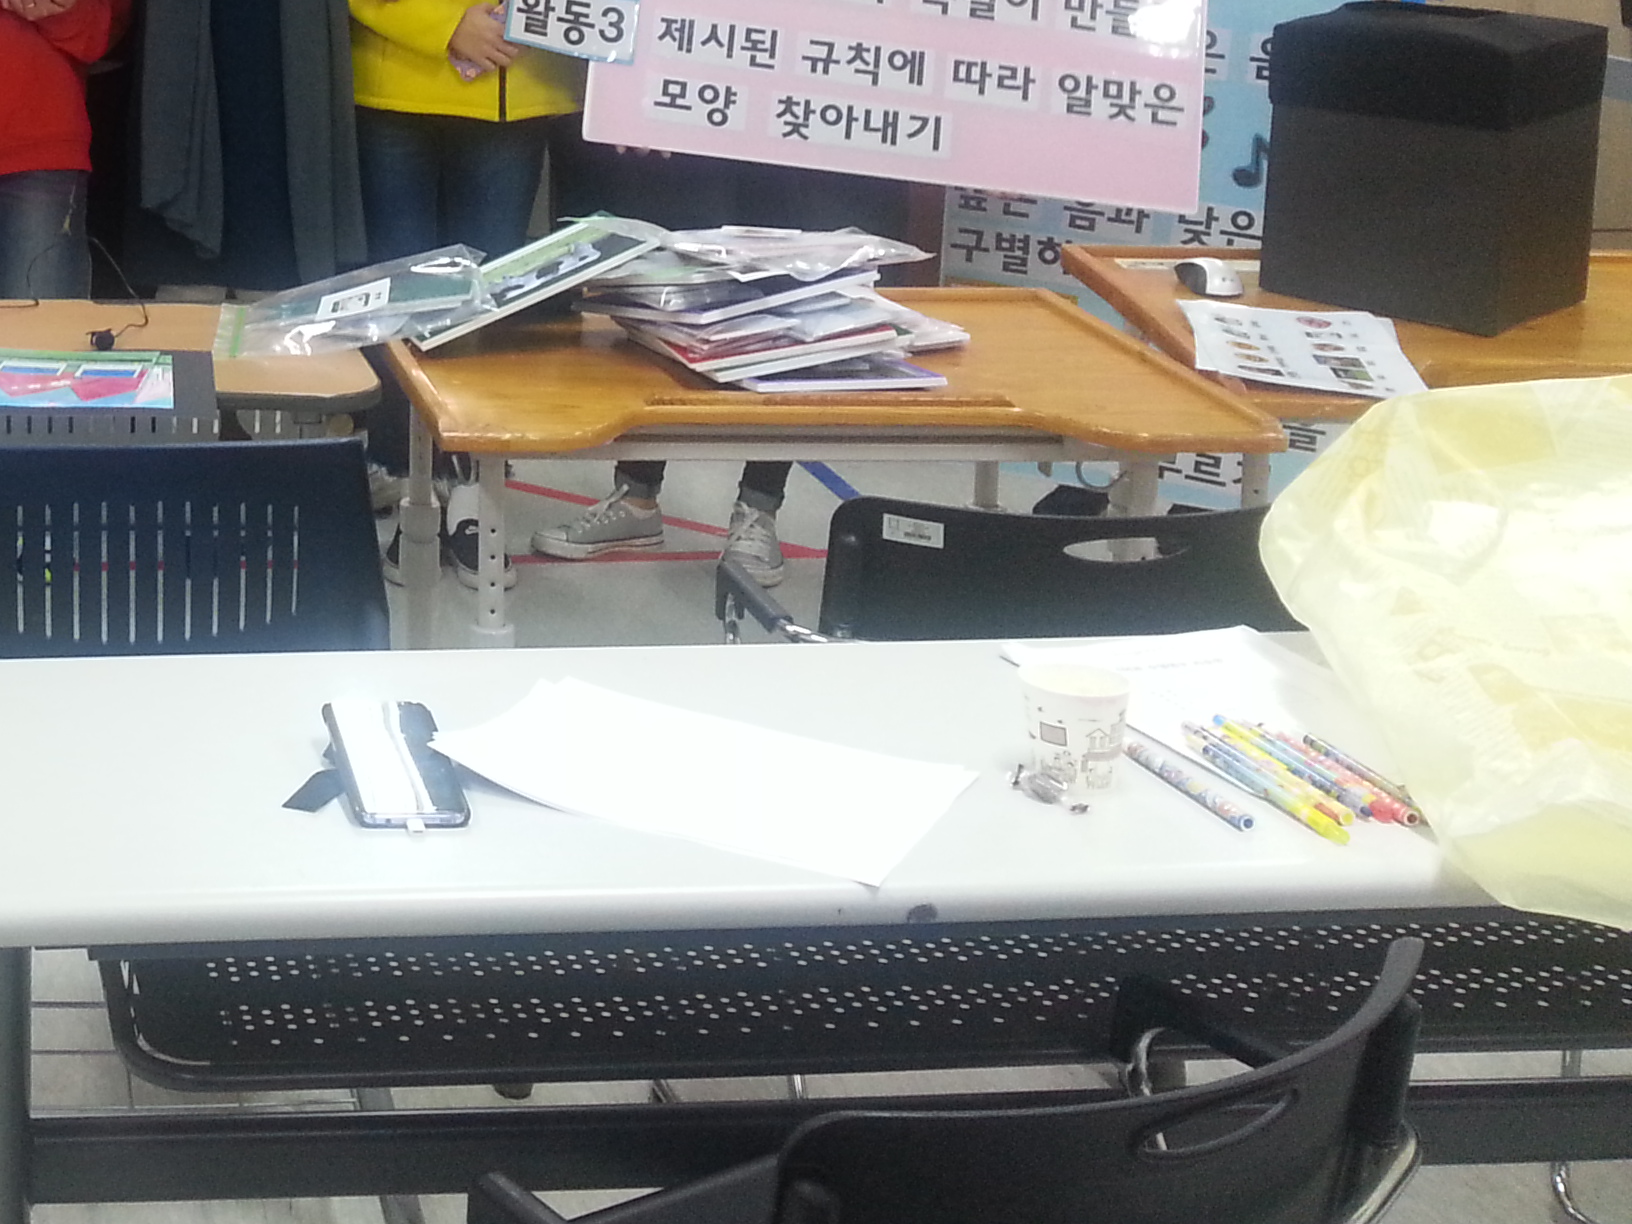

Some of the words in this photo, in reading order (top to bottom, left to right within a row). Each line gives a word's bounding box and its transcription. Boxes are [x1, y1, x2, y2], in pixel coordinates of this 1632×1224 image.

[653, 77, 738, 129] 모양
[774, 94, 943, 153] 찾아내기
[656, 14, 780, 71] 제시된
[800, 38, 927, 88] 규칙에
[952, 57, 1037, 103] 따라
[1057, 72, 1186, 128] 알맞은
